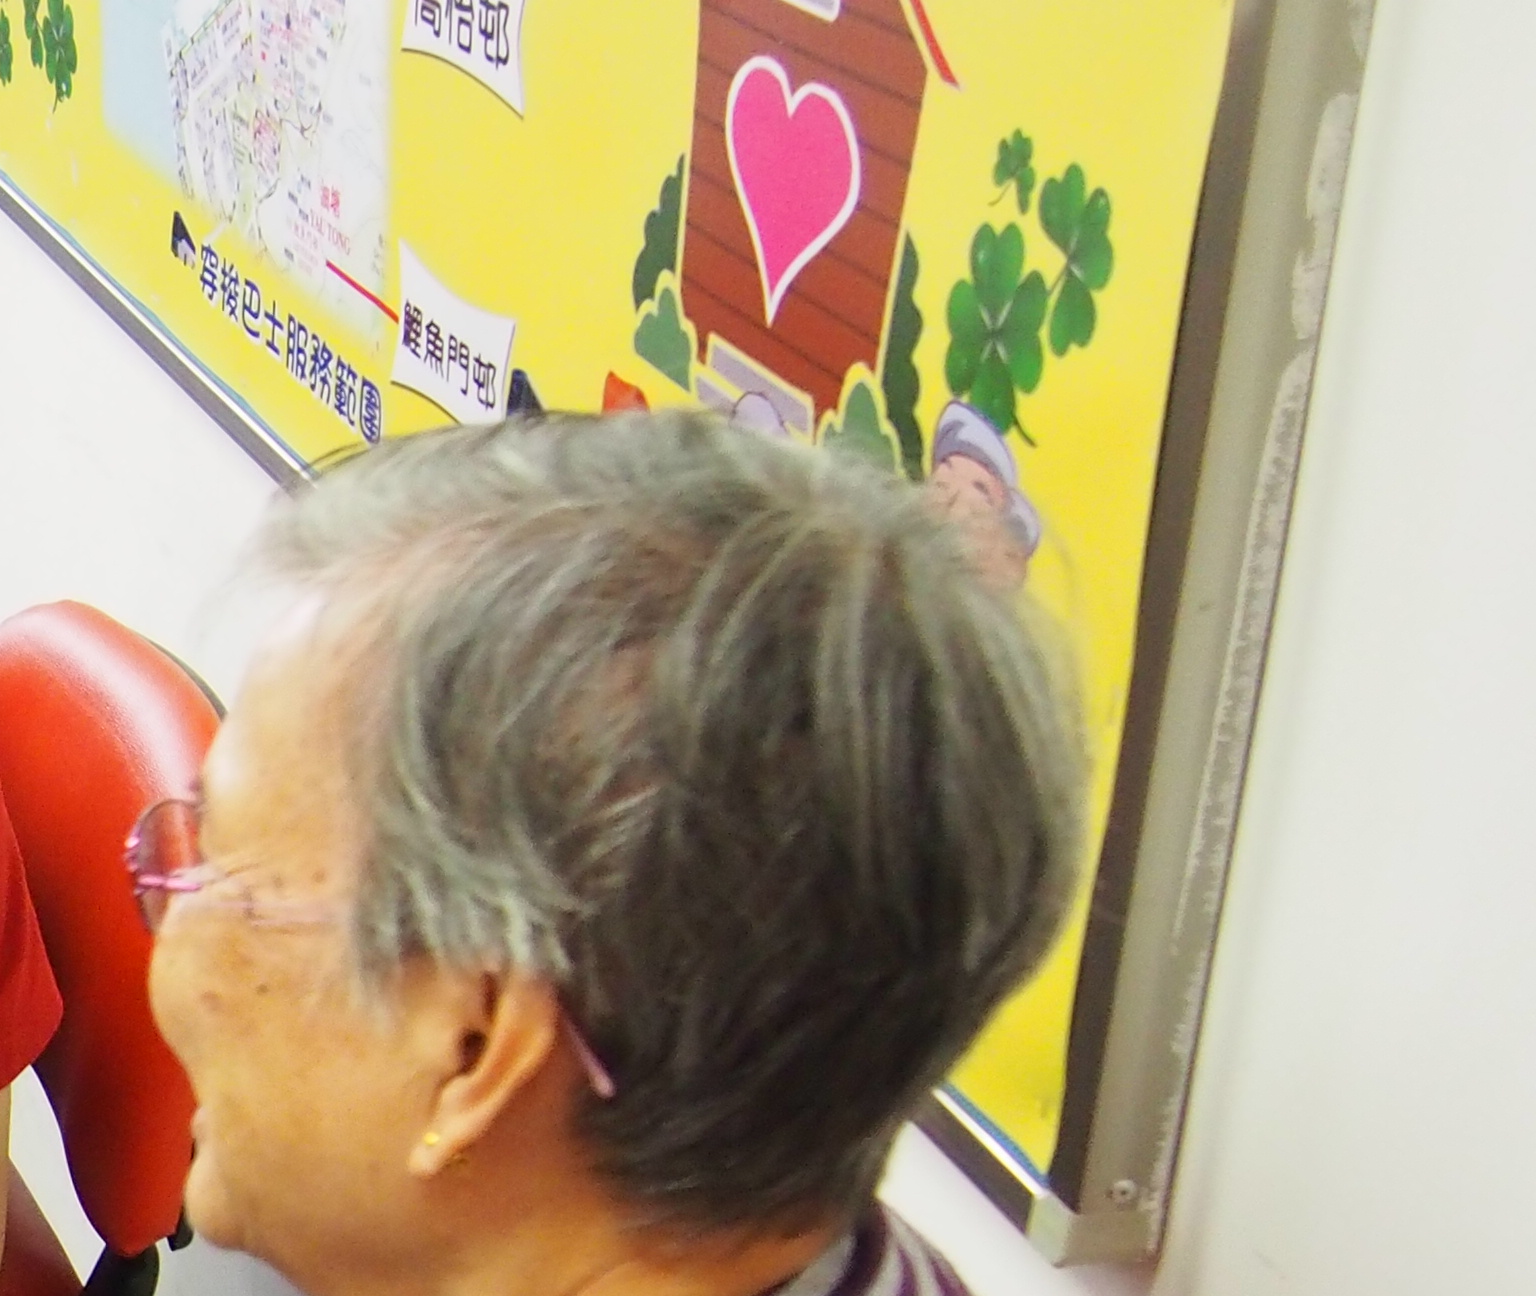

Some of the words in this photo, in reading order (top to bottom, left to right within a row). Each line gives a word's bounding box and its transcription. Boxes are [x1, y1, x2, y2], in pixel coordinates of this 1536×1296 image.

[199, 245, 381, 444] 穿梭巴士服務範圍
[402, 299, 497, 411] 鯉魚門邨
